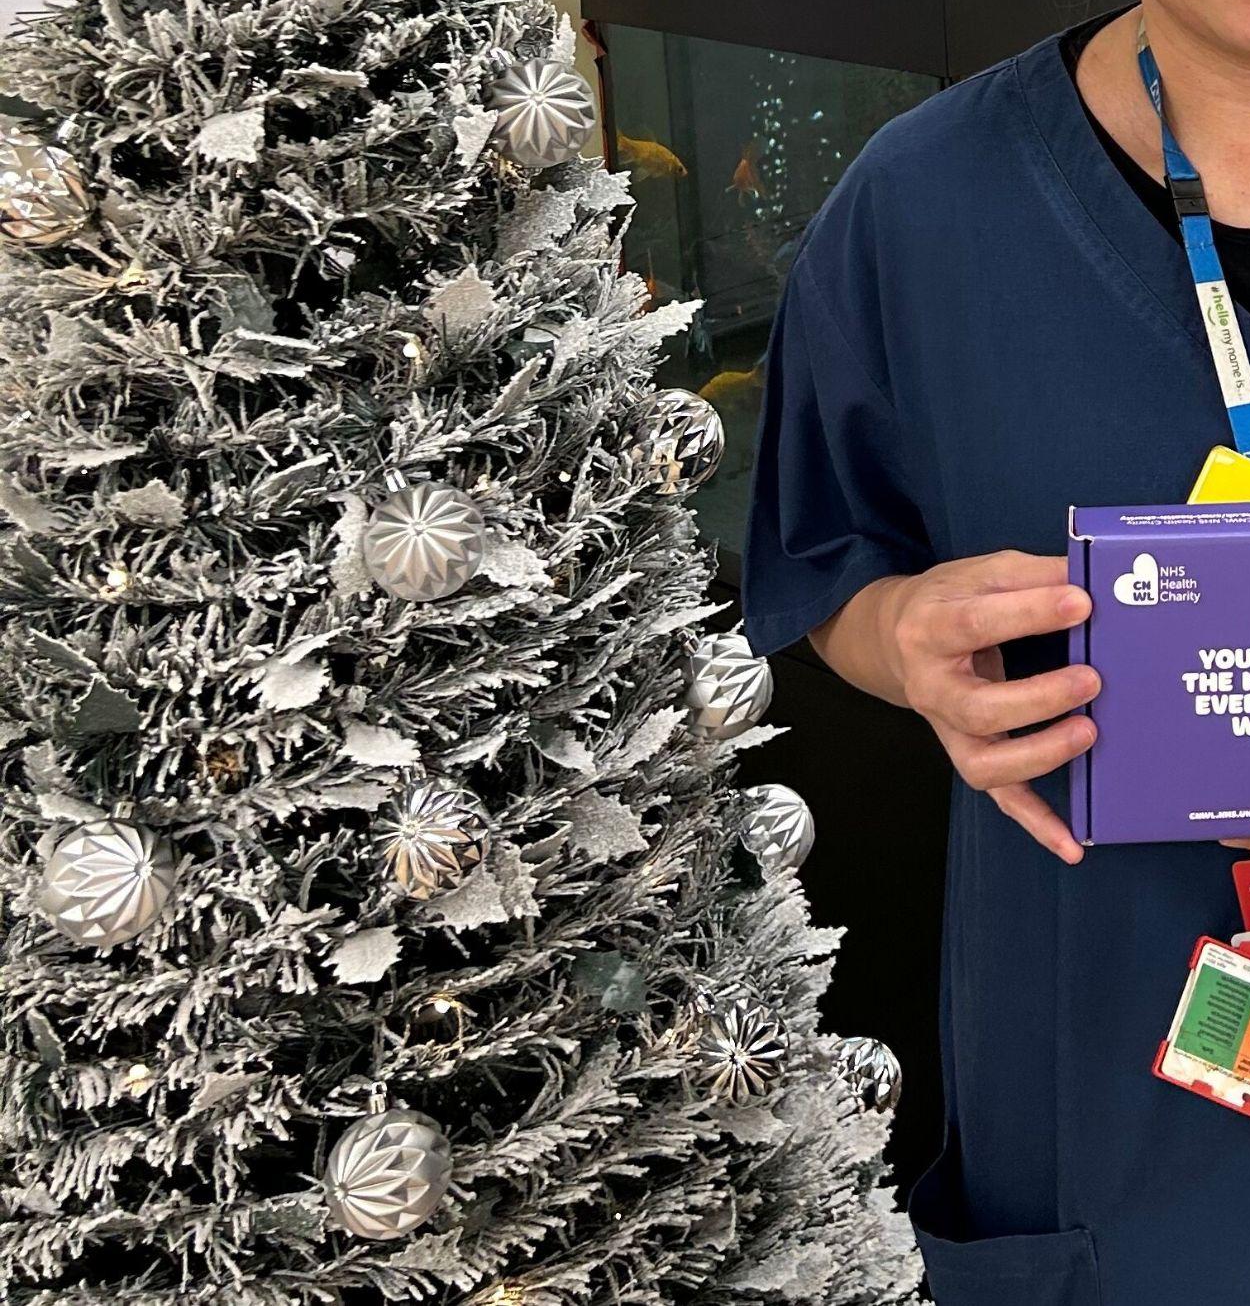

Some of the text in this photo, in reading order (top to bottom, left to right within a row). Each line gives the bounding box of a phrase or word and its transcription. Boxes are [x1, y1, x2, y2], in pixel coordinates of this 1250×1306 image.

[1222, 328, 1233, 345] my
[1228, 347, 1241, 378] name
[1160, 565, 1185, 577] NHS
[1133, 580, 1152, 591] CN
[1160, 577, 1198, 590] Health
[1133, 592, 1155, 602] WL
[1160, 590, 1201, 604] Charity
[1182, 672, 1233, 693] THE
